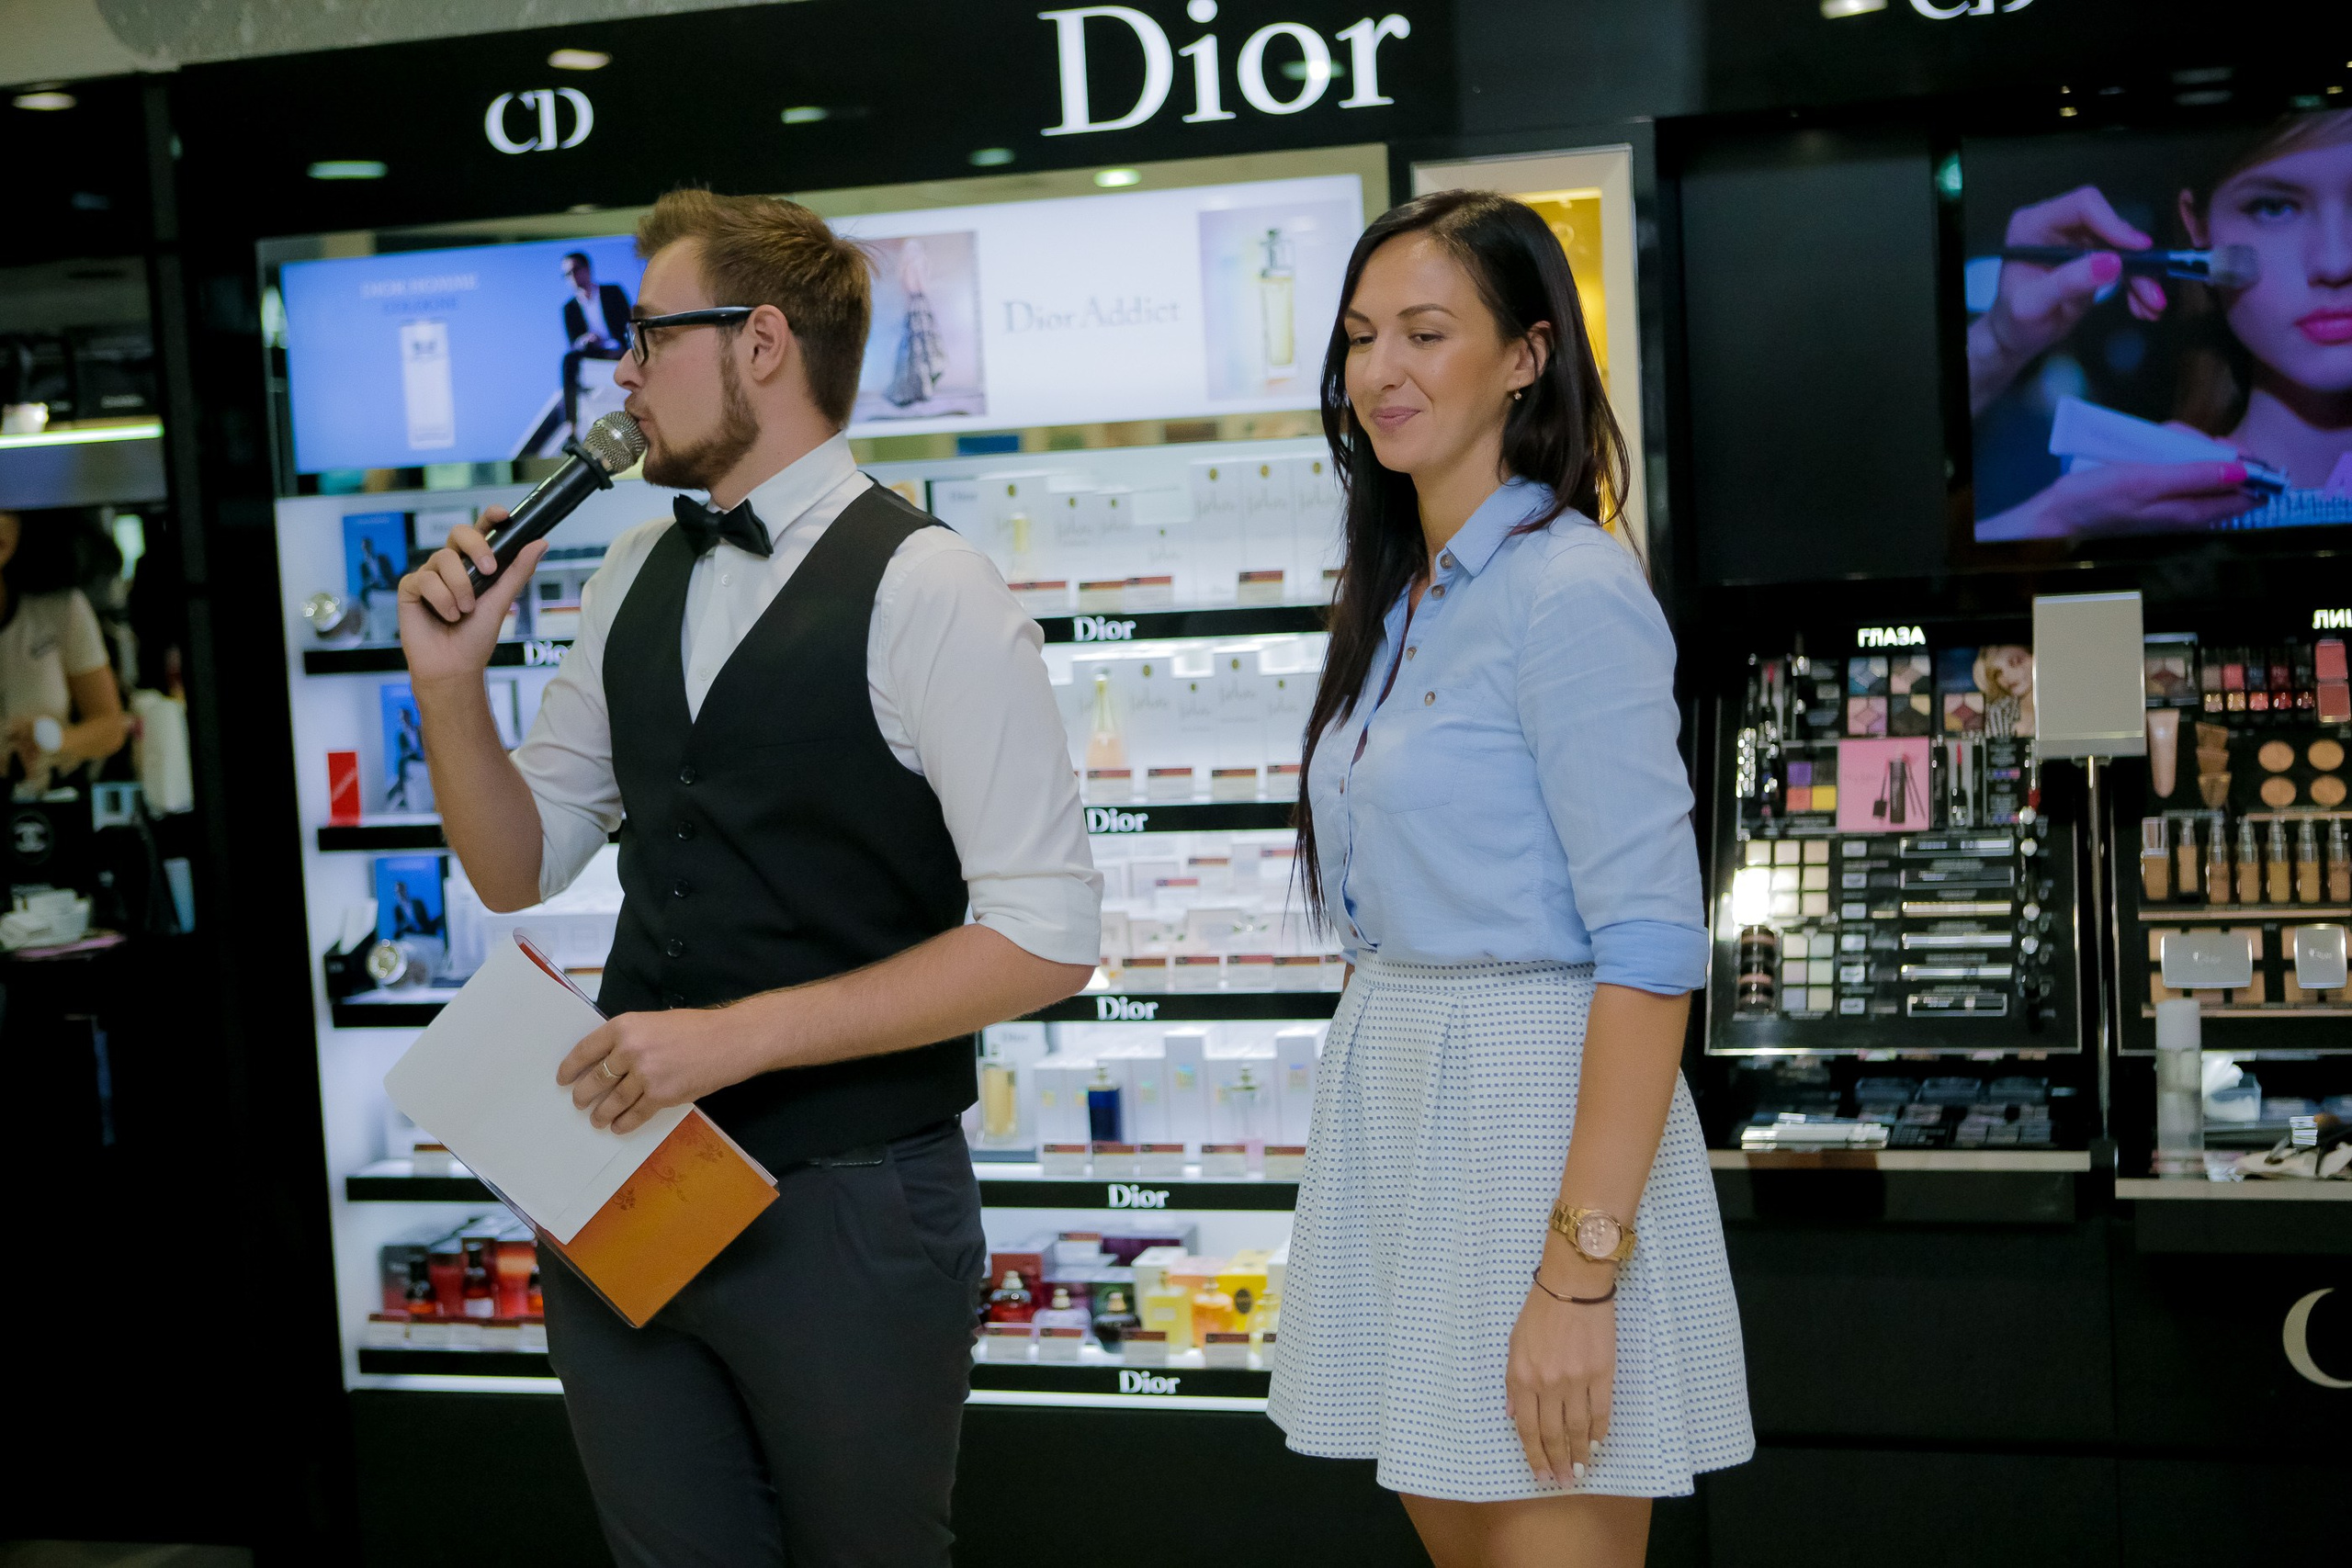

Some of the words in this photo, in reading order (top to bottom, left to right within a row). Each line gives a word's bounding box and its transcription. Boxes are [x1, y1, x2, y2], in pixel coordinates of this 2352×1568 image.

[1037, 0, 1411, 136] Dior
[484, 87, 594, 154] CD
[1002, 299, 1075, 333] Dior
[1079, 295, 1181, 328] Addict
[1073, 615, 1136, 641] Dior
[1858, 626, 1926, 648] ГЛАЗА
[525, 640, 571, 666] Dio
[1086, 807, 1148, 832] Dior
[1096, 996, 1159, 1021] Dior
[1108, 1184, 1170, 1209] Dior
[1119, 1371, 1181, 1394] Dior
